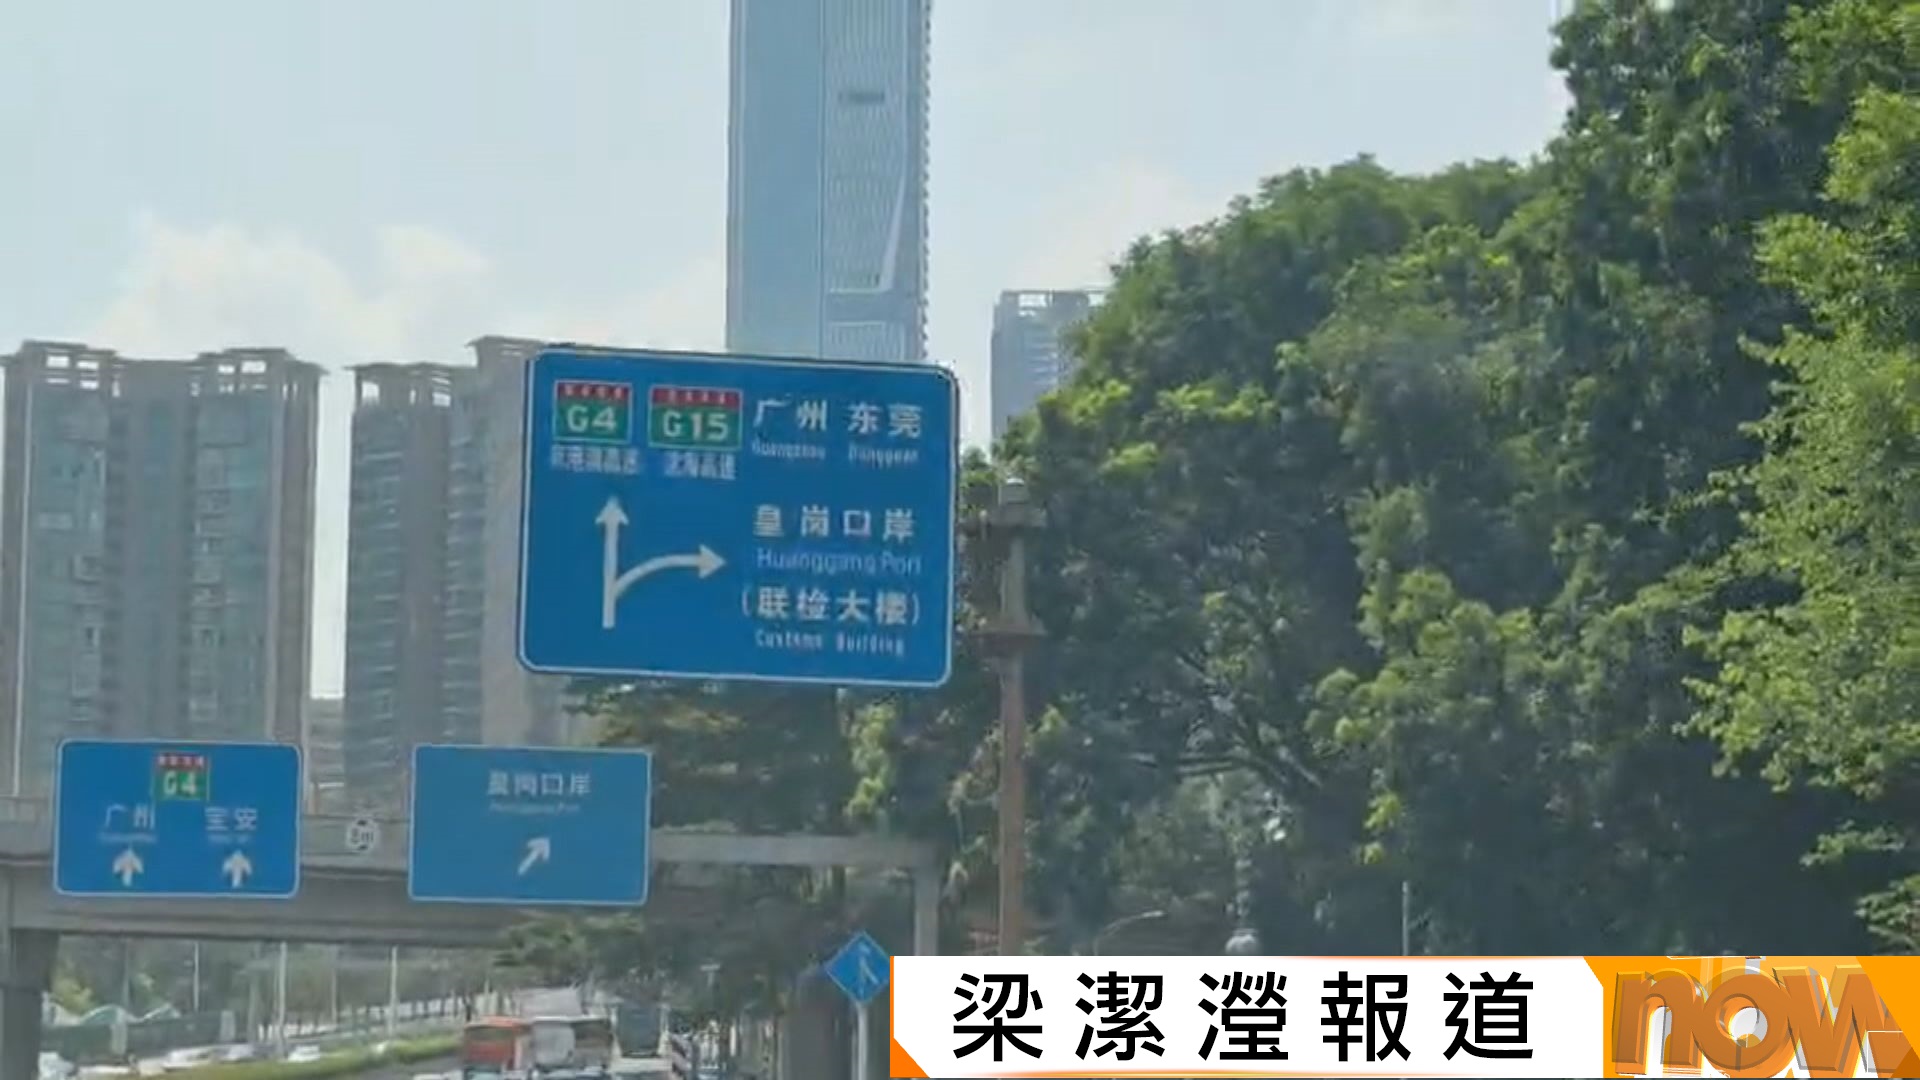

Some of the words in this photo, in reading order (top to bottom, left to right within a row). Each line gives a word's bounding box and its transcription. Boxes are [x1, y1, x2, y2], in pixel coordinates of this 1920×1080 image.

[567, 405, 617, 433] G4
[663, 410, 729, 441] G15
[753, 394, 827, 431] 广州
[848, 402, 922, 439] 东莞
[753, 504, 915, 542] 皇岗口岸
[757, 548, 876, 575] Huanggang
[164, 770, 197, 796] G4
[105, 803, 155, 829] 广州
